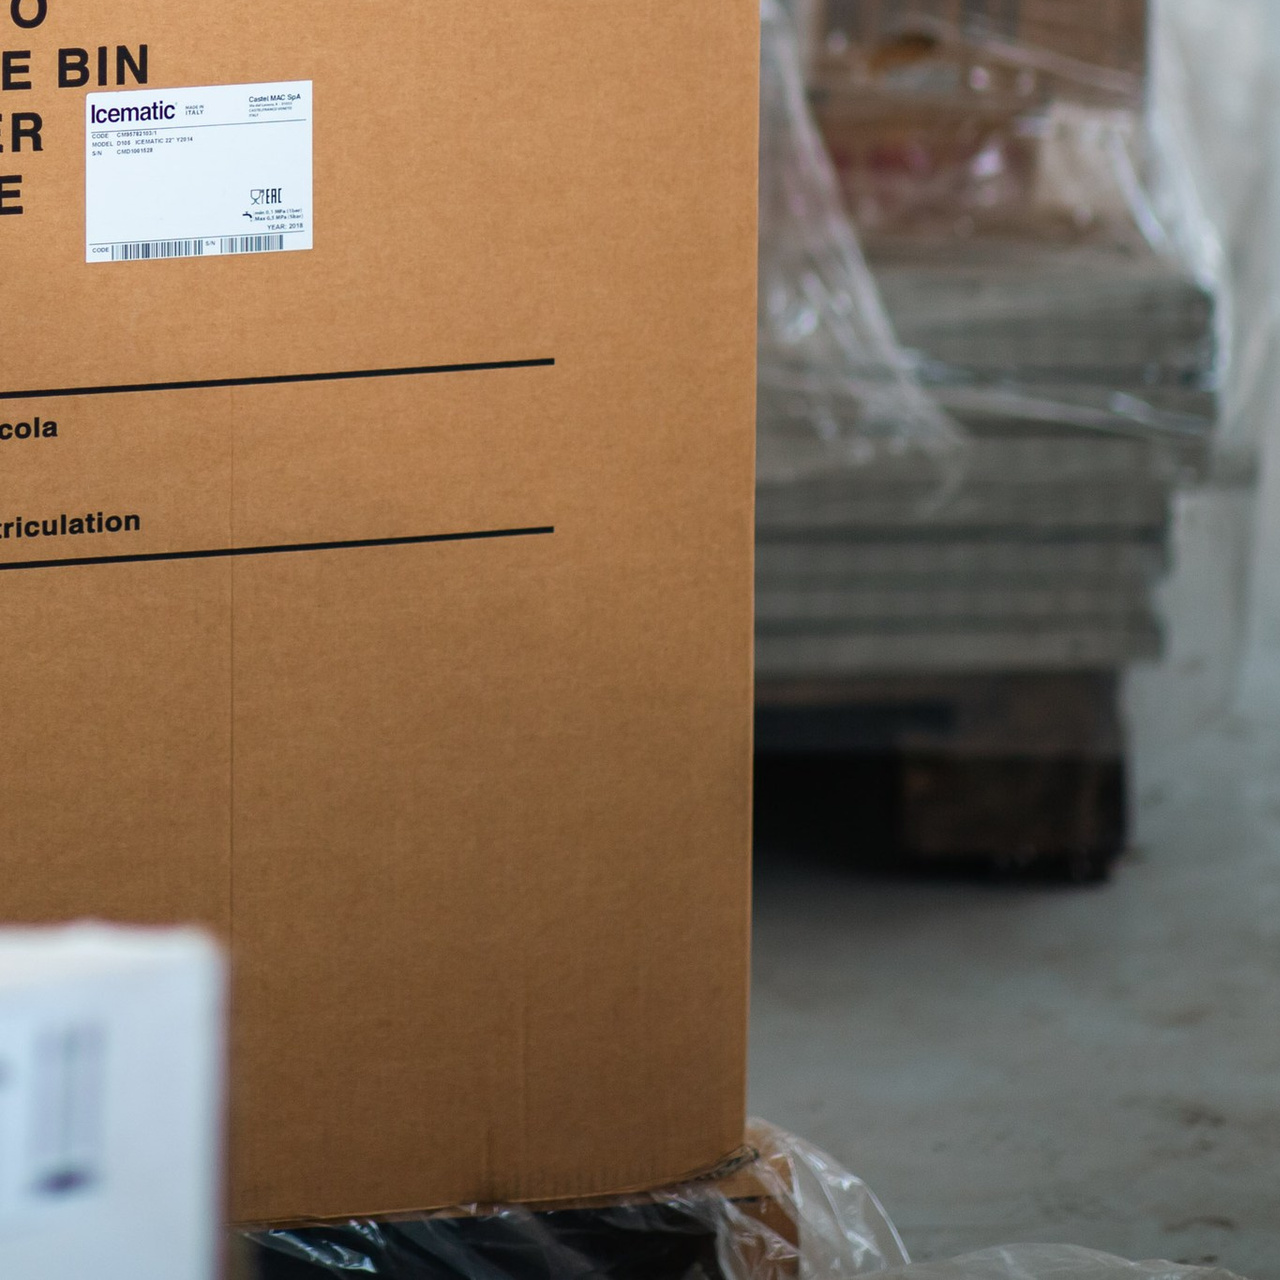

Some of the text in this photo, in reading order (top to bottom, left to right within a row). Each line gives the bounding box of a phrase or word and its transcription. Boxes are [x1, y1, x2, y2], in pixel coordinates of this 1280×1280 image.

[58, 44, 148, 89] BIN
[287, 93, 302, 102] SpA
[91, 100, 176, 124] Icematic
[135, 137, 164, 145] ICEMATIC
[266, 188, 282, 204] EAC
[267, 223, 287, 231] YEAR:
